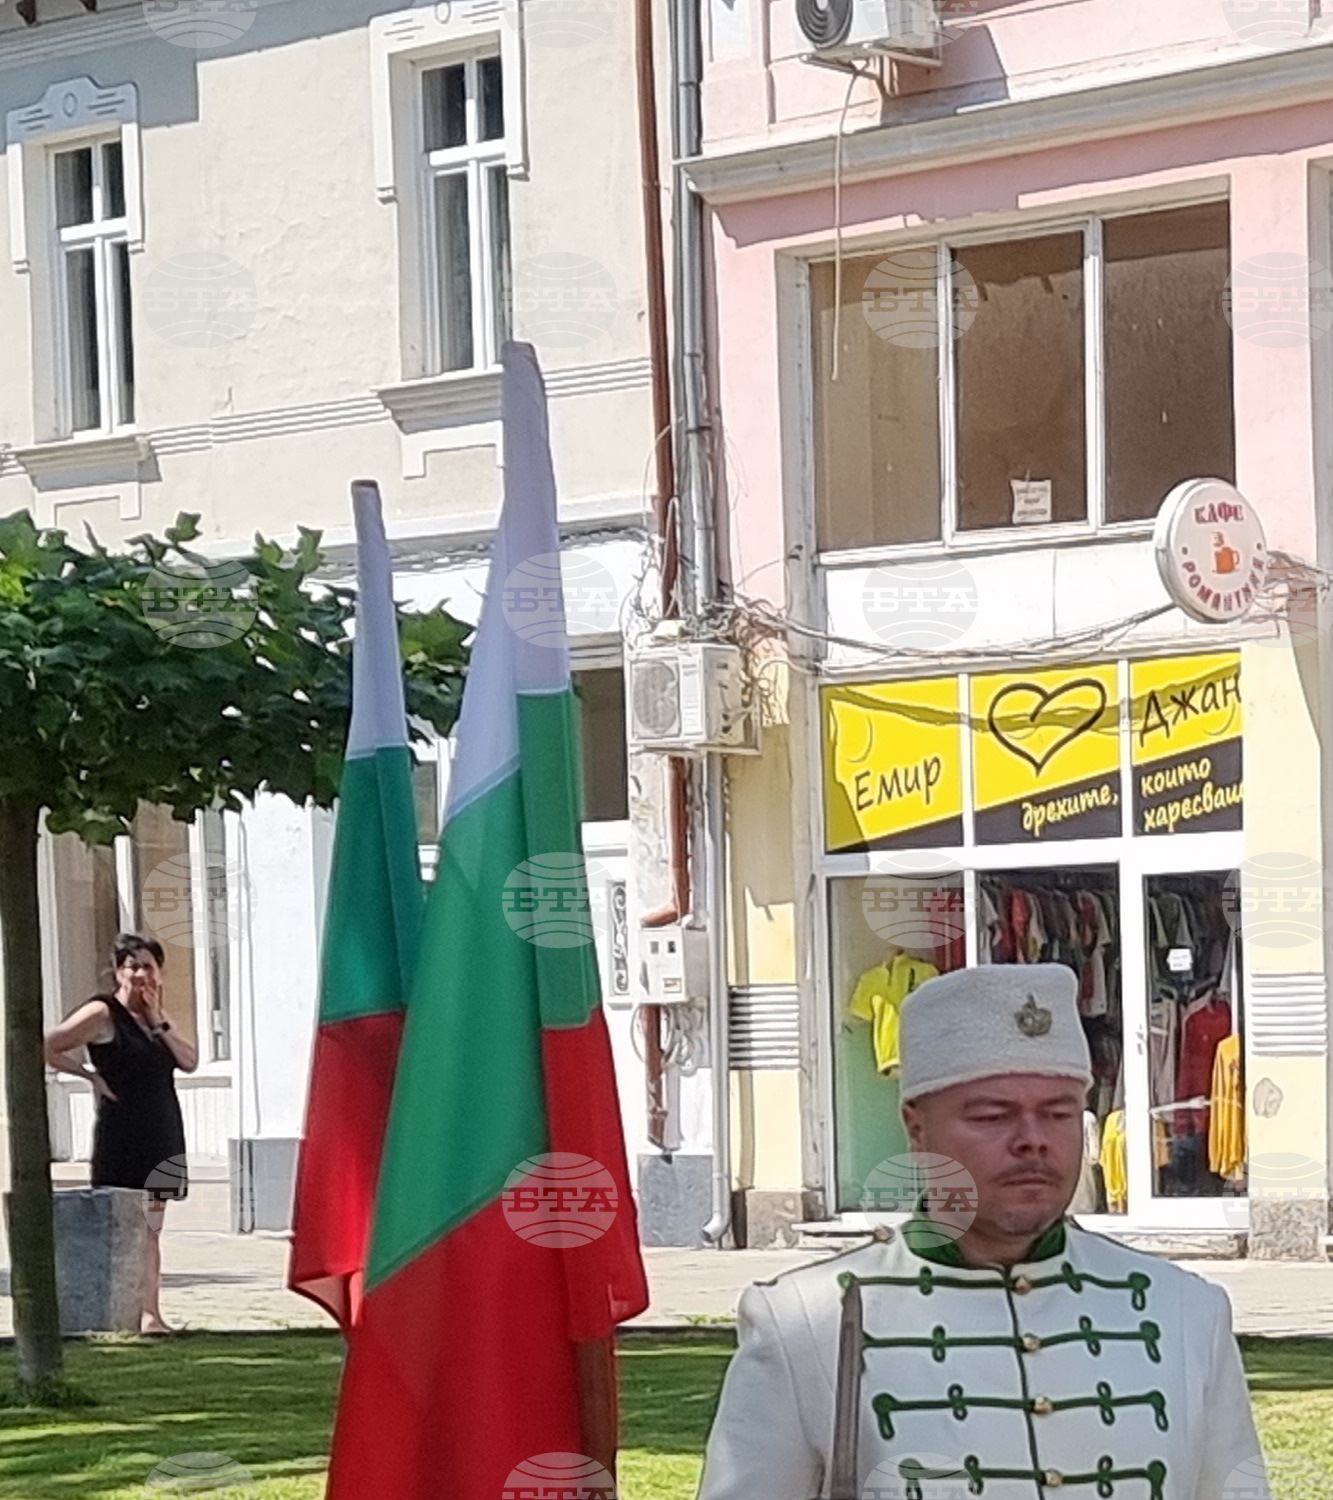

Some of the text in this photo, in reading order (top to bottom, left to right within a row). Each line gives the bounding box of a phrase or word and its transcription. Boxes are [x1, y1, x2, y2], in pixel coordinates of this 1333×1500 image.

[1194, 501, 1244, 524] КАФЕ
[855, 672, 1242, 811] Емир Джан
[1021, 757, 1212, 838] дрехите, които
